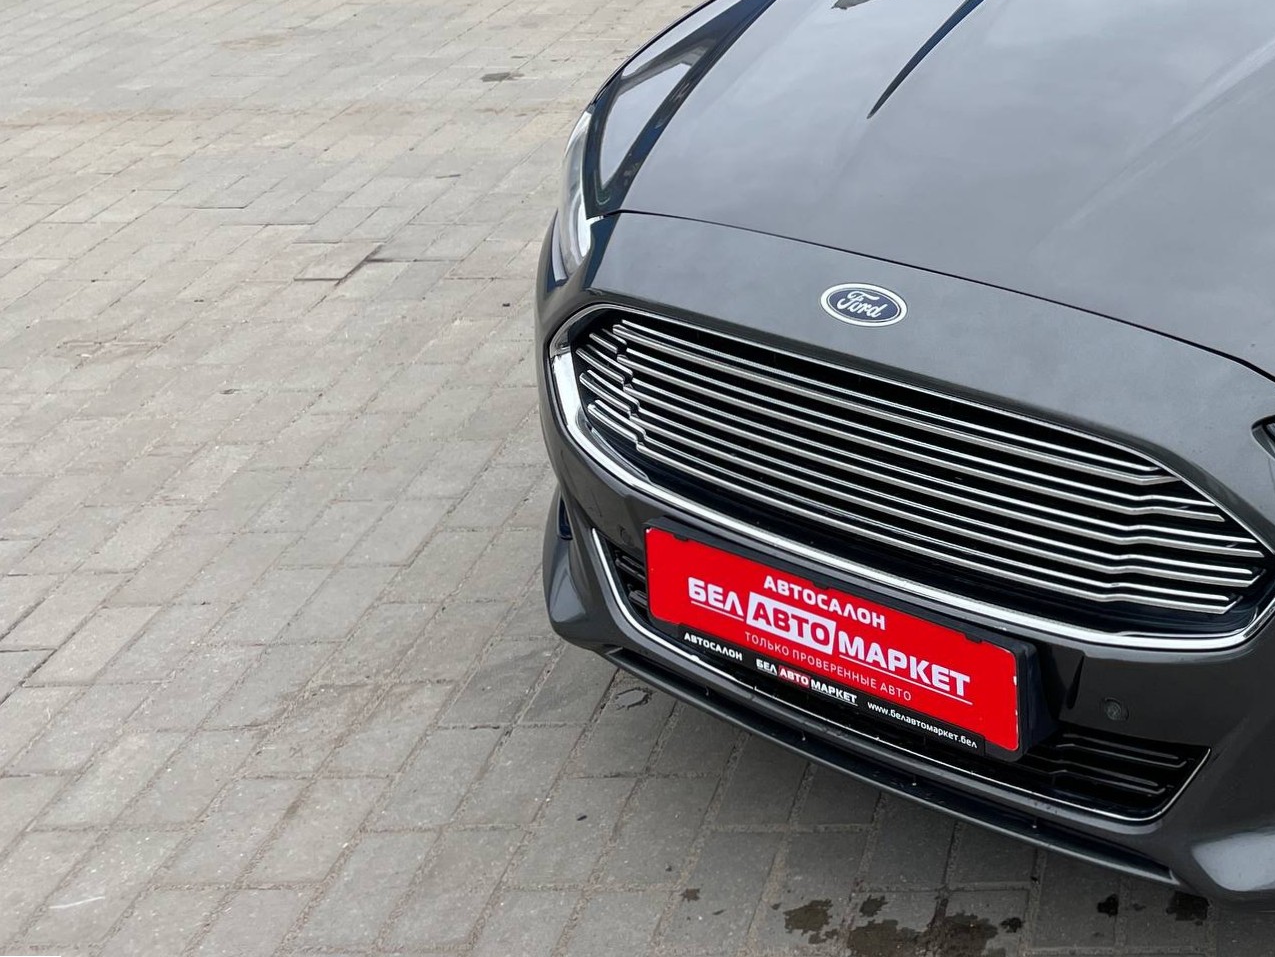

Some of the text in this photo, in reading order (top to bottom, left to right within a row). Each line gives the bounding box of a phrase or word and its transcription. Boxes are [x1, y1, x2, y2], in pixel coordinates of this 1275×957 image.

[836, 290, 888, 318] Ford
[687, 577, 971, 697] БЕЛ АВТО МАРКЕТ
[763, 575, 886, 630] АВТОСАЛОН
[684, 632, 743, 661] АВТОСАЛОН
[756, 658, 778, 675] БЕЛ
[778, 667, 810, 687] АВТО
[810, 678, 858, 704] МАРКЕТ
[744, 631, 912, 702] ТОЛЬКО ПРОВЕРЕННЫЕ АВТО
